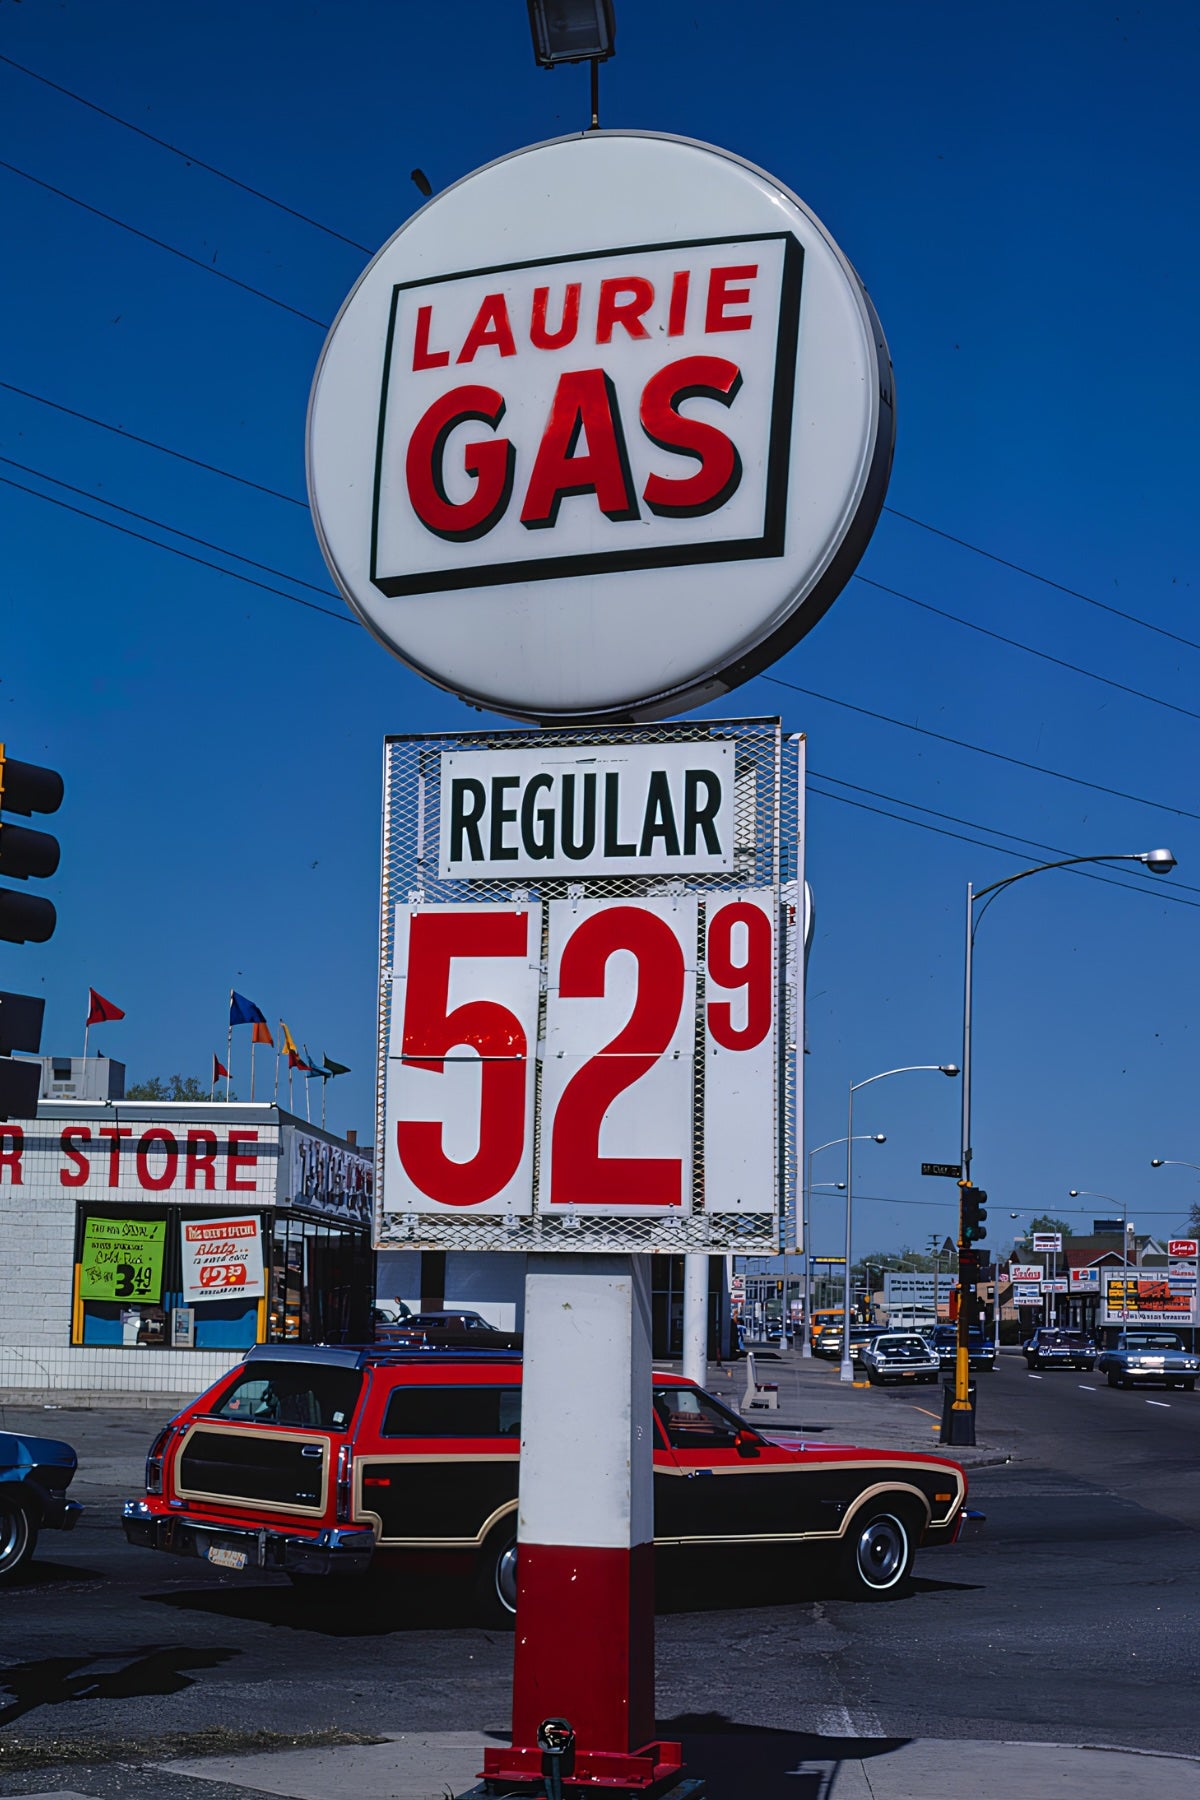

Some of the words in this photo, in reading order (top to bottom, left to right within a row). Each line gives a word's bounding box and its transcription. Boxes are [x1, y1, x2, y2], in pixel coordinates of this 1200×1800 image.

[412, 264, 758, 372] LAURIE
[406, 355, 743, 542] GAS
[450, 769, 723, 862] REGULAR
[60, 1126, 259, 1191] STORE
